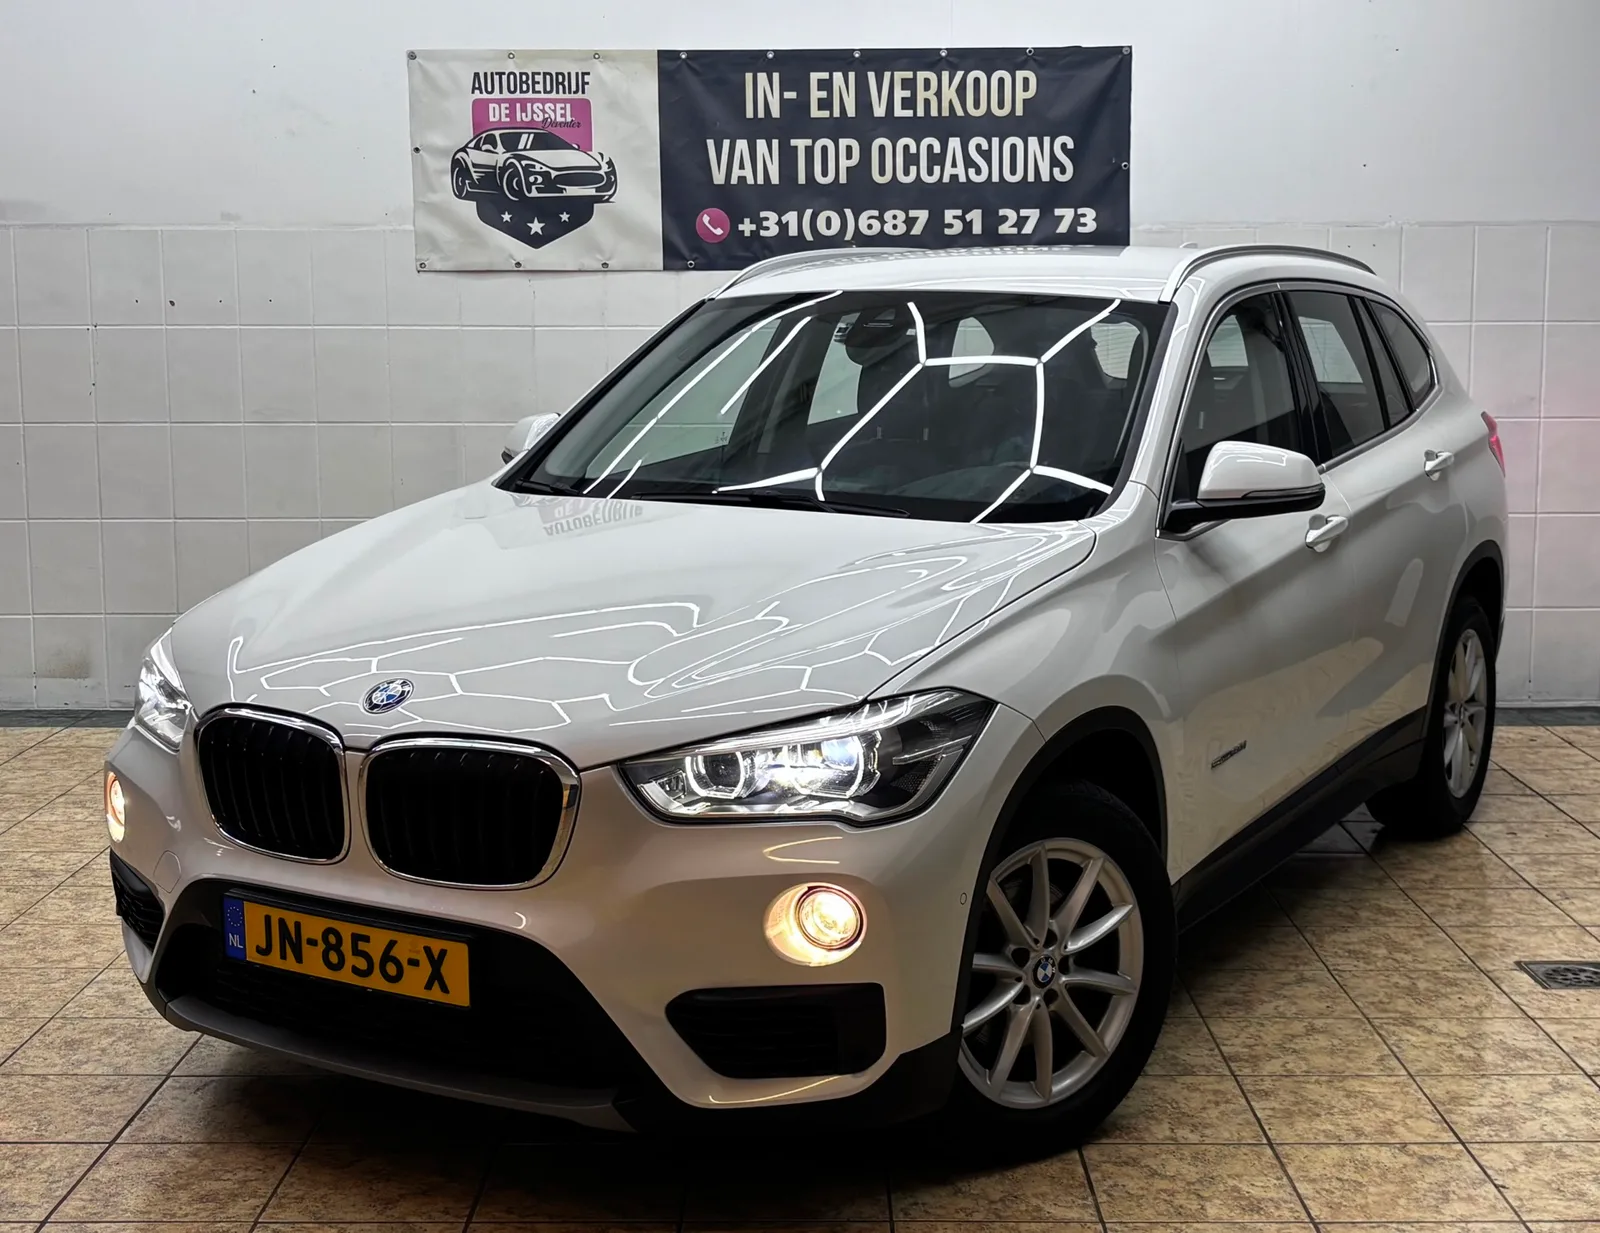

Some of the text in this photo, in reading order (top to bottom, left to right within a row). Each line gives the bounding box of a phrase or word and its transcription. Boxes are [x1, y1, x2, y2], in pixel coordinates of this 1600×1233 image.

[471, 72, 590, 95] AUTOBEDRIJF
[744, 70, 1038, 119] IN- EN VERKOOP
[489, 102, 575, 122] DE IJSSEL
[541, 117, 582, 129] Deventer
[706, 135, 1075, 185] VAN TOP OCCASIONS
[738, 207, 1097, 241] +31(0)687 51 27 73
[228, 932, 244, 949] NL
[255, 914, 450, 995] JN-856-X
